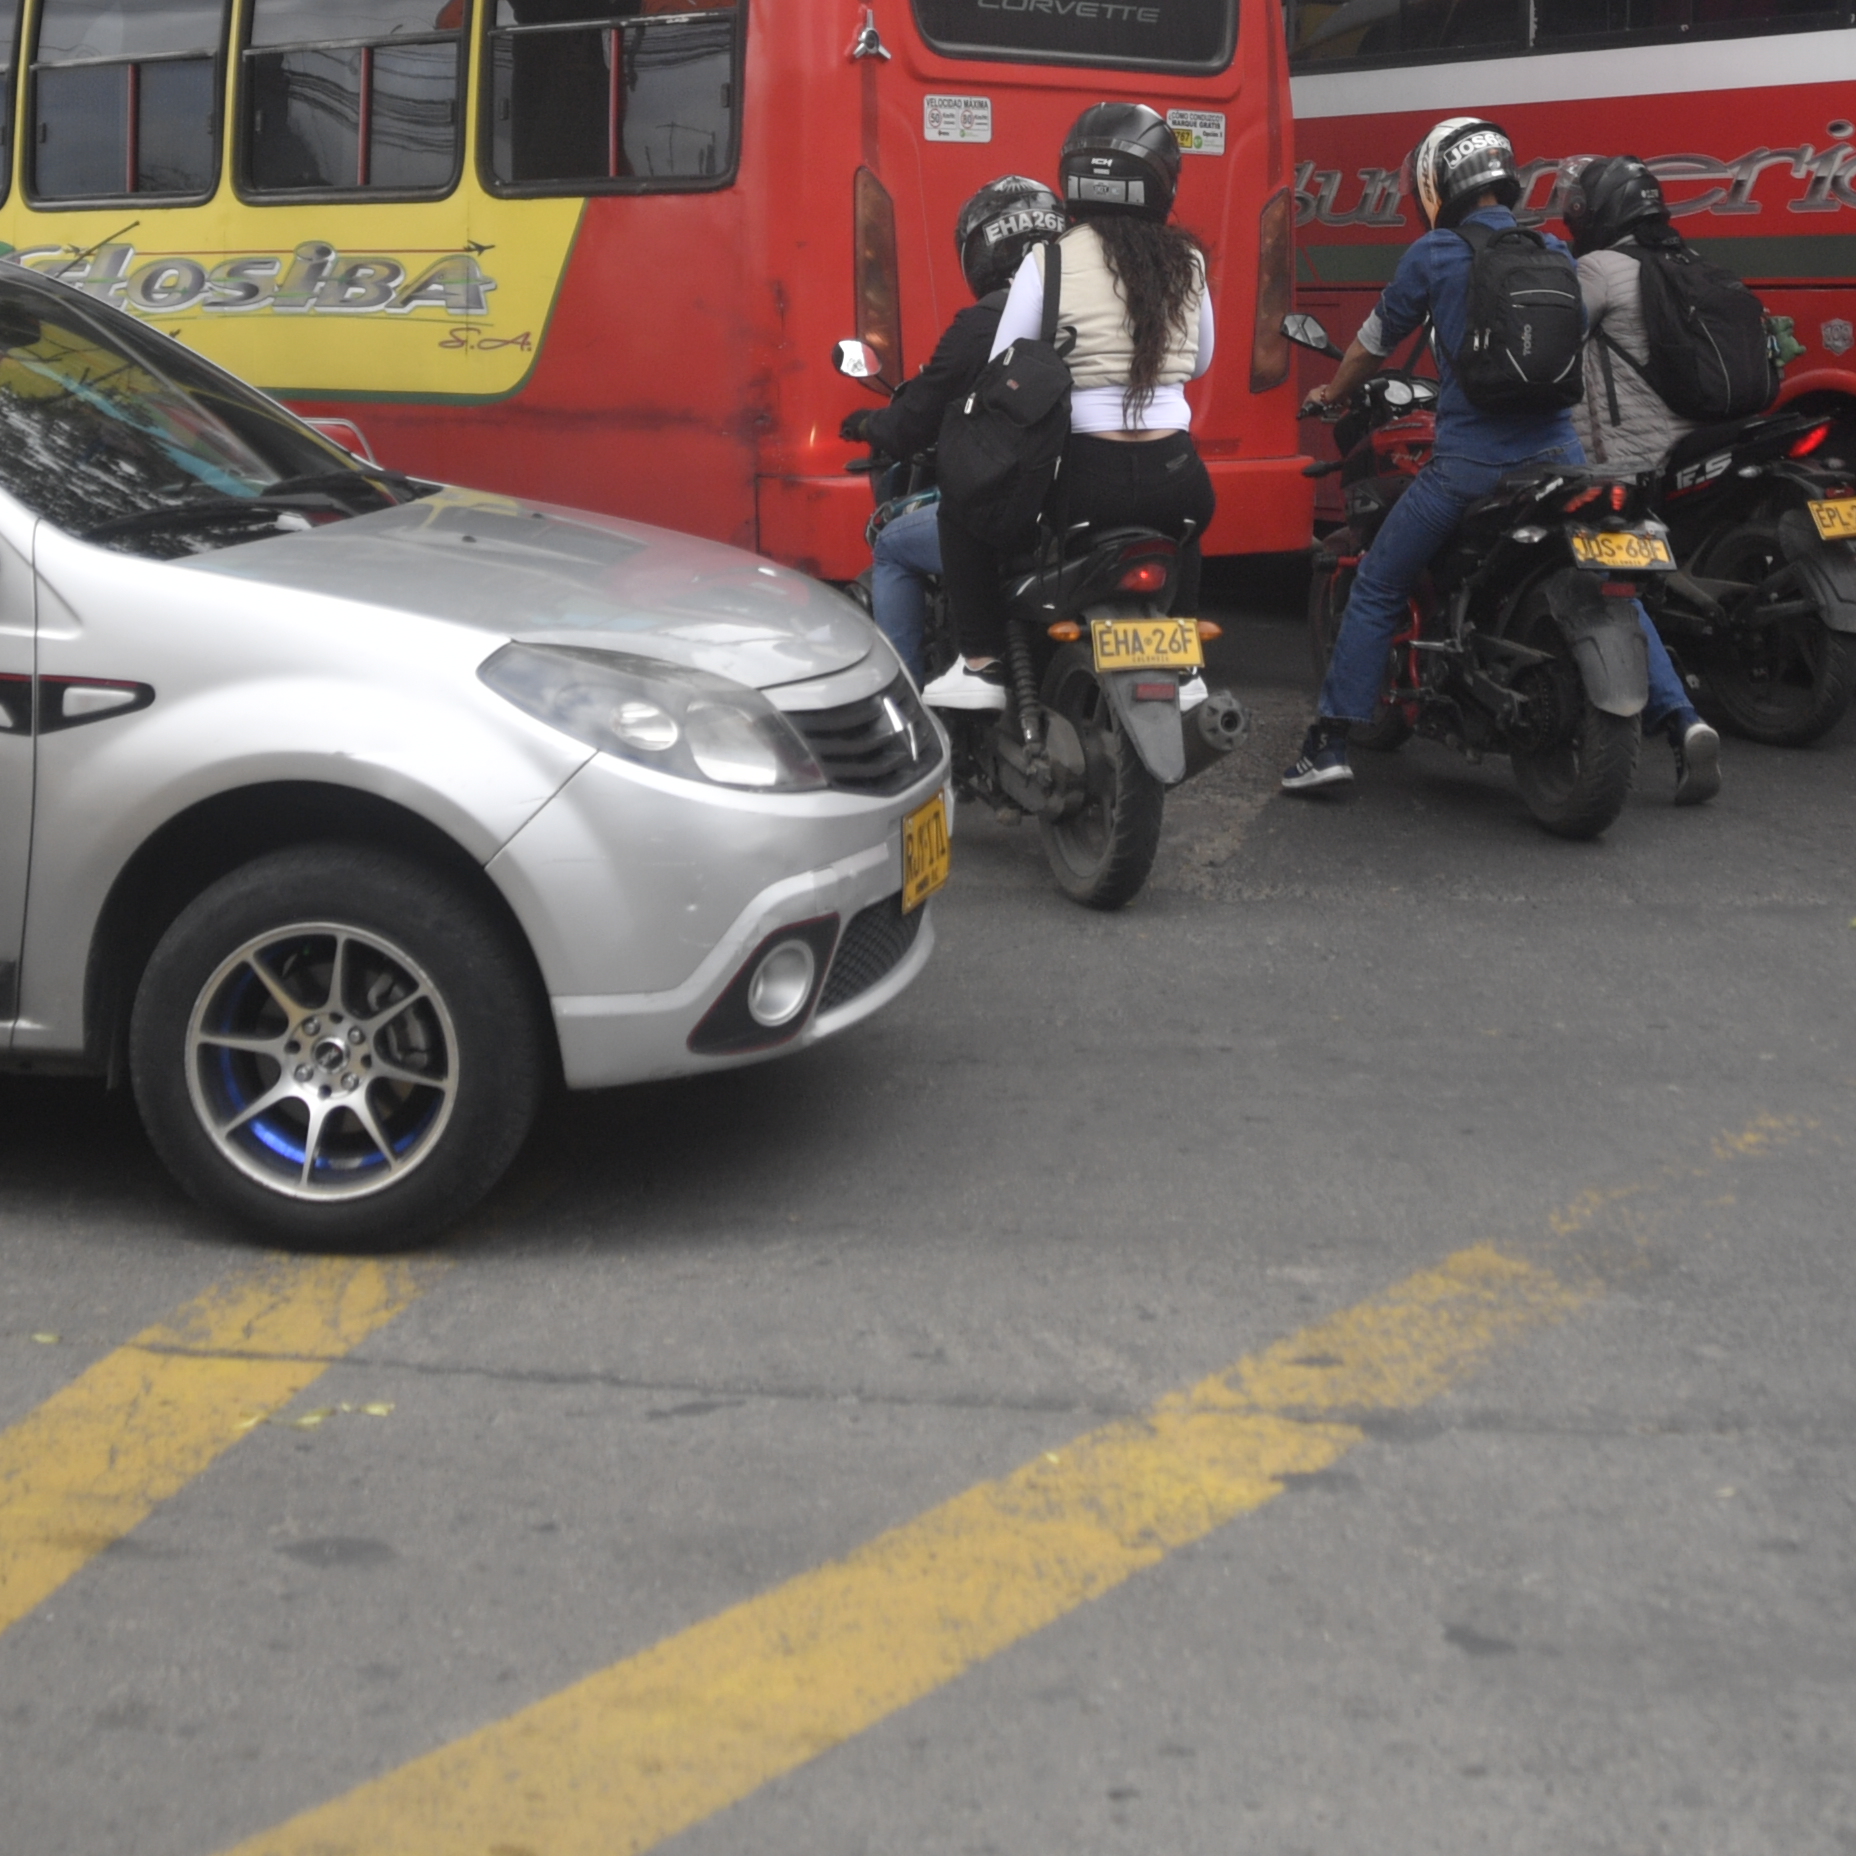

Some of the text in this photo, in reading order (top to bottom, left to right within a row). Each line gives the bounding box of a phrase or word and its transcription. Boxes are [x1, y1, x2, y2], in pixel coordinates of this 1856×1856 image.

[926, 98, 962, 109] VELOCIDAD
[1172, 120, 1220, 129] MARQUE GRATIS
